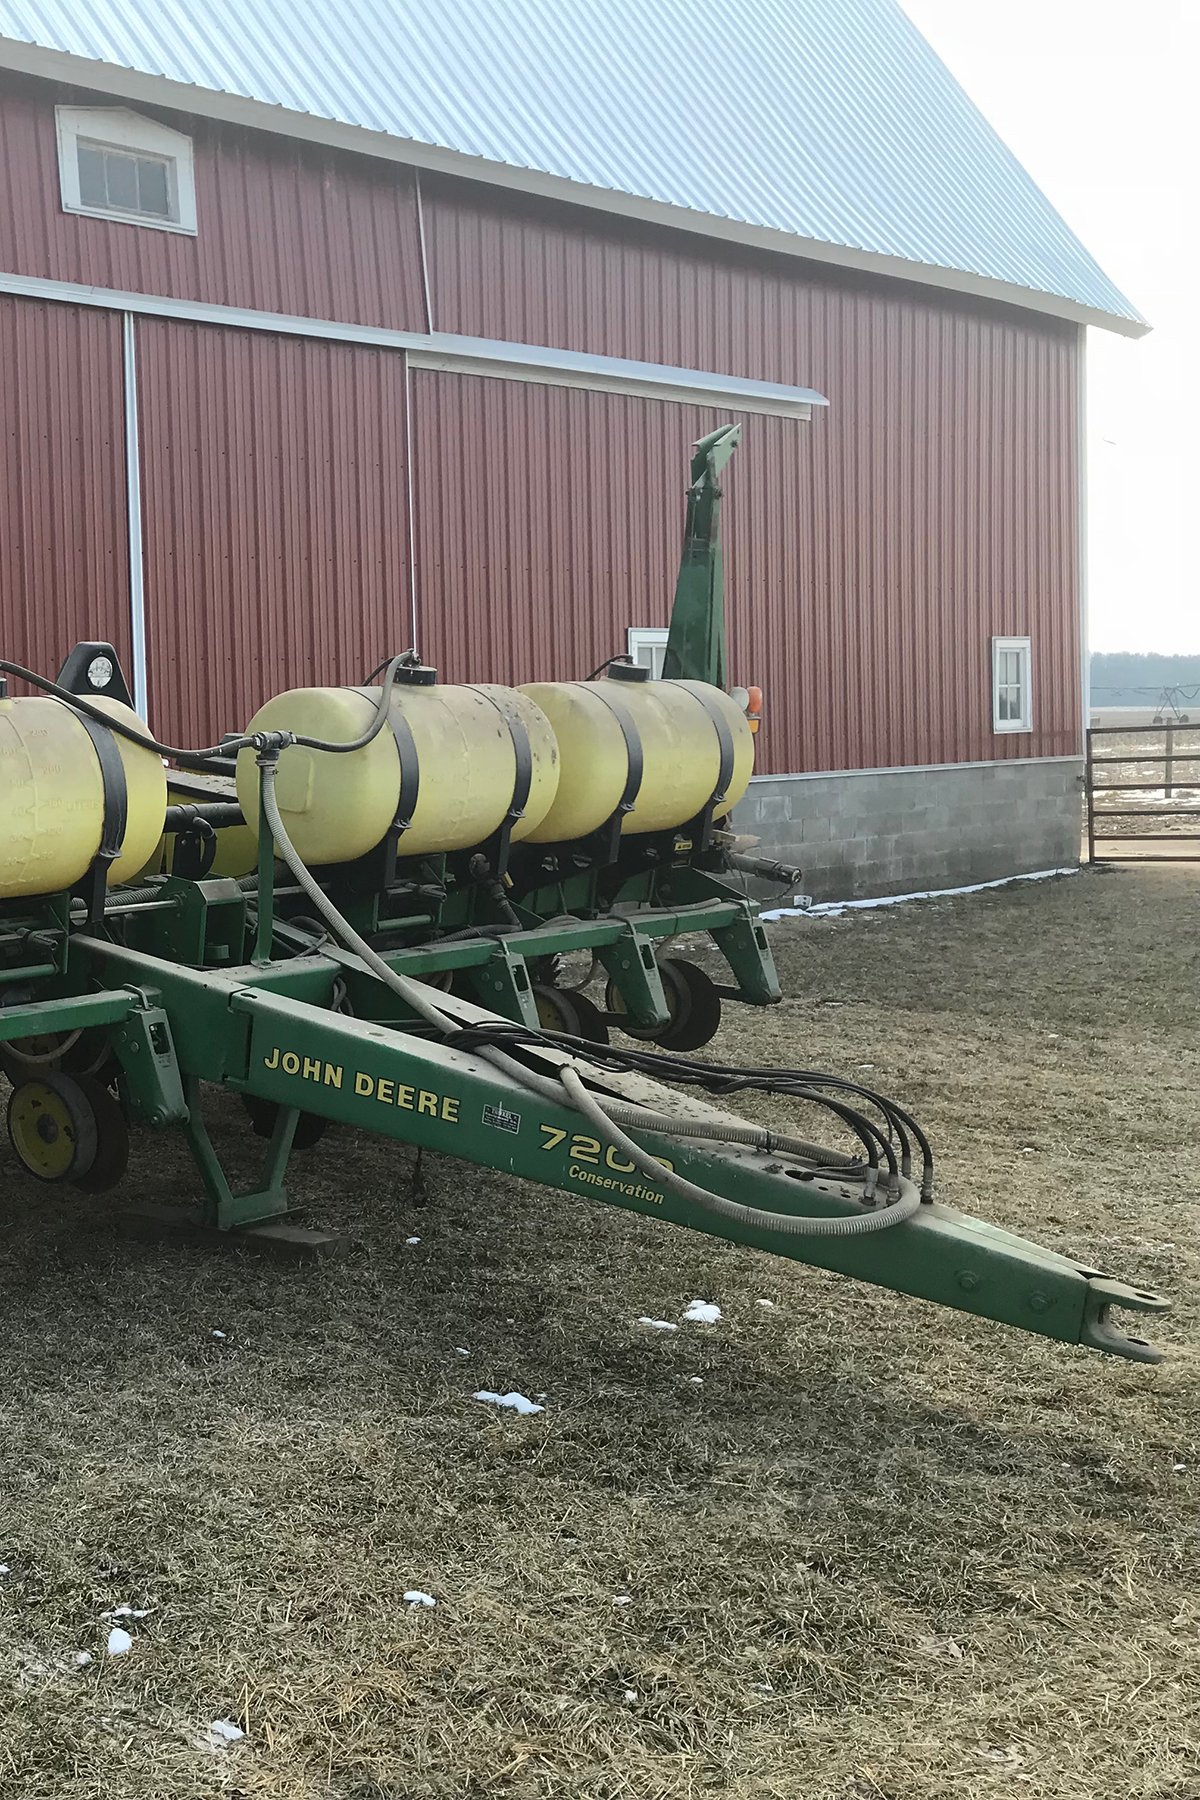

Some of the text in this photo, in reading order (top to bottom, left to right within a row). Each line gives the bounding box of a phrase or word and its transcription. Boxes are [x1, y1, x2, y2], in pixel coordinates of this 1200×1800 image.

[264, 1048, 343, 1089] JOHN
[354, 1071, 461, 1123] DEERE
[568, 1164, 665, 1205] Conservation
